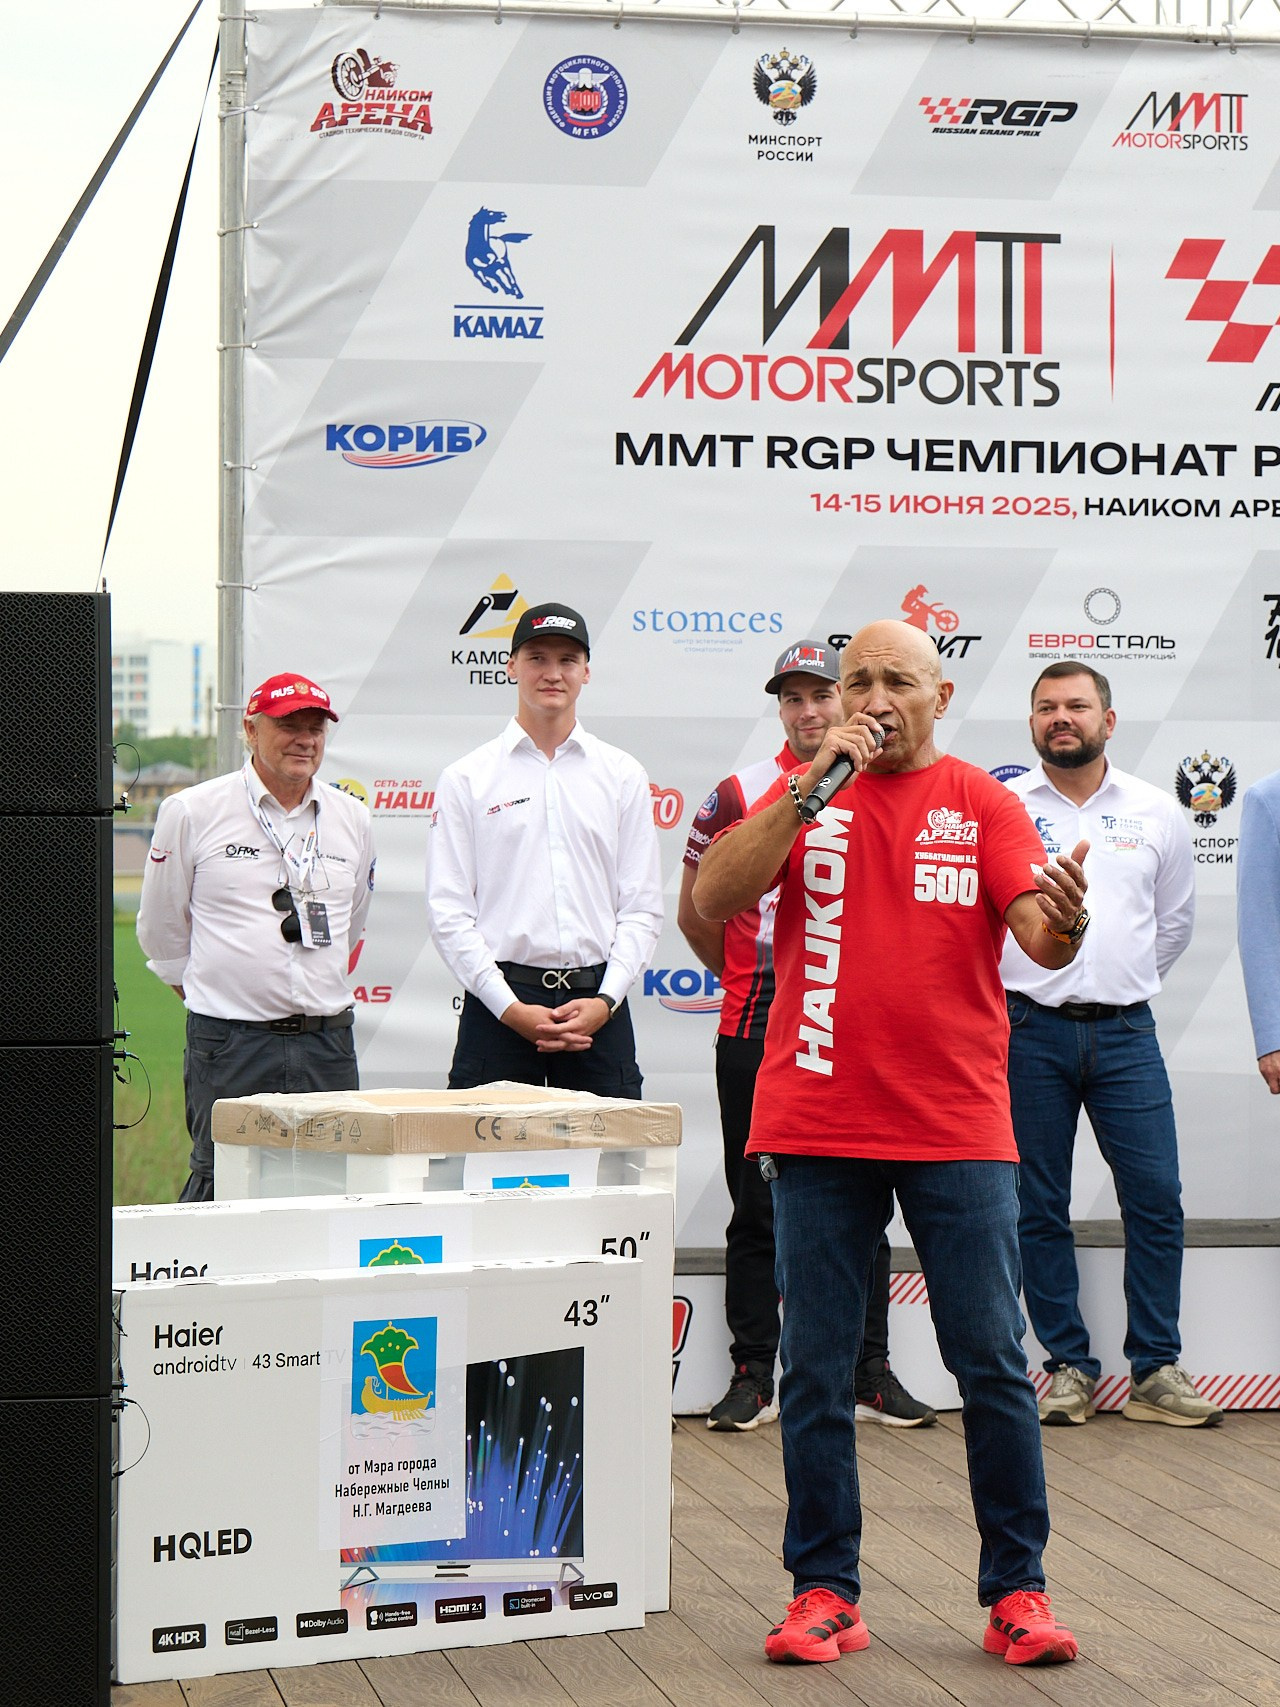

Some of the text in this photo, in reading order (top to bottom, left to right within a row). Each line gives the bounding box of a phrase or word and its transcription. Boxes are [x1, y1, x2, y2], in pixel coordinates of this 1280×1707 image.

[609, 70, 625, 98] СПОРТА
[364, 89, 433, 102] НАИКОМ
[310, 102, 433, 134] АРЕНА
[607, 99, 625, 127] РОССИИ
[961, 98, 1079, 128] RGP
[1125, 91, 1249, 134] MMT
[572, 126, 599, 137] MFR
[748, 134, 823, 147] МИНСПОРТ
[932, 127, 1042, 138] RUSSIAN GRAND PRIX
[1112, 132, 1249, 151] MOTORSPORTS
[757, 150, 813, 162] РОССИИ
[673, 224, 1062, 356] MMT
[453, 315, 544, 340] KAMAZ
[632, 351, 1061, 408] MOTORSPORTS
[326, 424, 473, 453] КОРИБ
[615, 432, 754, 468] MMT
[766, 435, 875, 470] RGP
[886, 437, 1238, 477] ЧЕМПИОНАТ
[810, 493, 882, 513] 14-15
[889, 494, 984, 515] ИЮНЯ
[991, 495, 1078, 520] 2025,
[1084, 497, 1220, 518] НАИКОМ
[632, 608, 783, 634] stomces
[1028, 633, 1176, 650] ЕВРОСТАЛЬ
[452, 650, 510, 664] КАМС
[1028, 652, 1176, 661] ЗАВОД МЕТАЛЛОКОНСТРУКЦИЙ
[271, 685, 295, 699] RUS
[374, 780, 422, 788] СЕТЬ АЗС
[818, 777, 832, 789] 2
[915, 828, 978, 844] АРЕНА
[237, 846, 260, 857] FMC
[914, 863, 979, 907] 500
[542, 969, 572, 990] CK
[563, 1294, 611, 1328] 43"
[154, 1321, 224, 1350] Haier
[152, 1350, 239, 1376] androidtv
[252, 1354, 271, 1370] 43
[275, 1350, 321, 1369] Smart
[348, 1458, 437, 1476] от Мэра города
[335, 1477, 450, 1499] Набережные Челны
[353, 1501, 432, 1518] Н.Г. Магдеева
[153, 1527, 253, 1563] HQLED
[520, 1596, 546, 1605] Chromecast
[573, 1592, 603, 1602] EVO
[384, 1610, 411, 1619] Hands-free
[439, 1603, 470, 1615] HDMI
[471, 1602, 483, 1612] 2.1
[308, 1617, 345, 1629] Dolby Audio
[384, 1613, 414, 1624] voice control
[157, 1630, 201, 1648] 4K HDR
[245, 1626, 276, 1636] Bezel-Less
